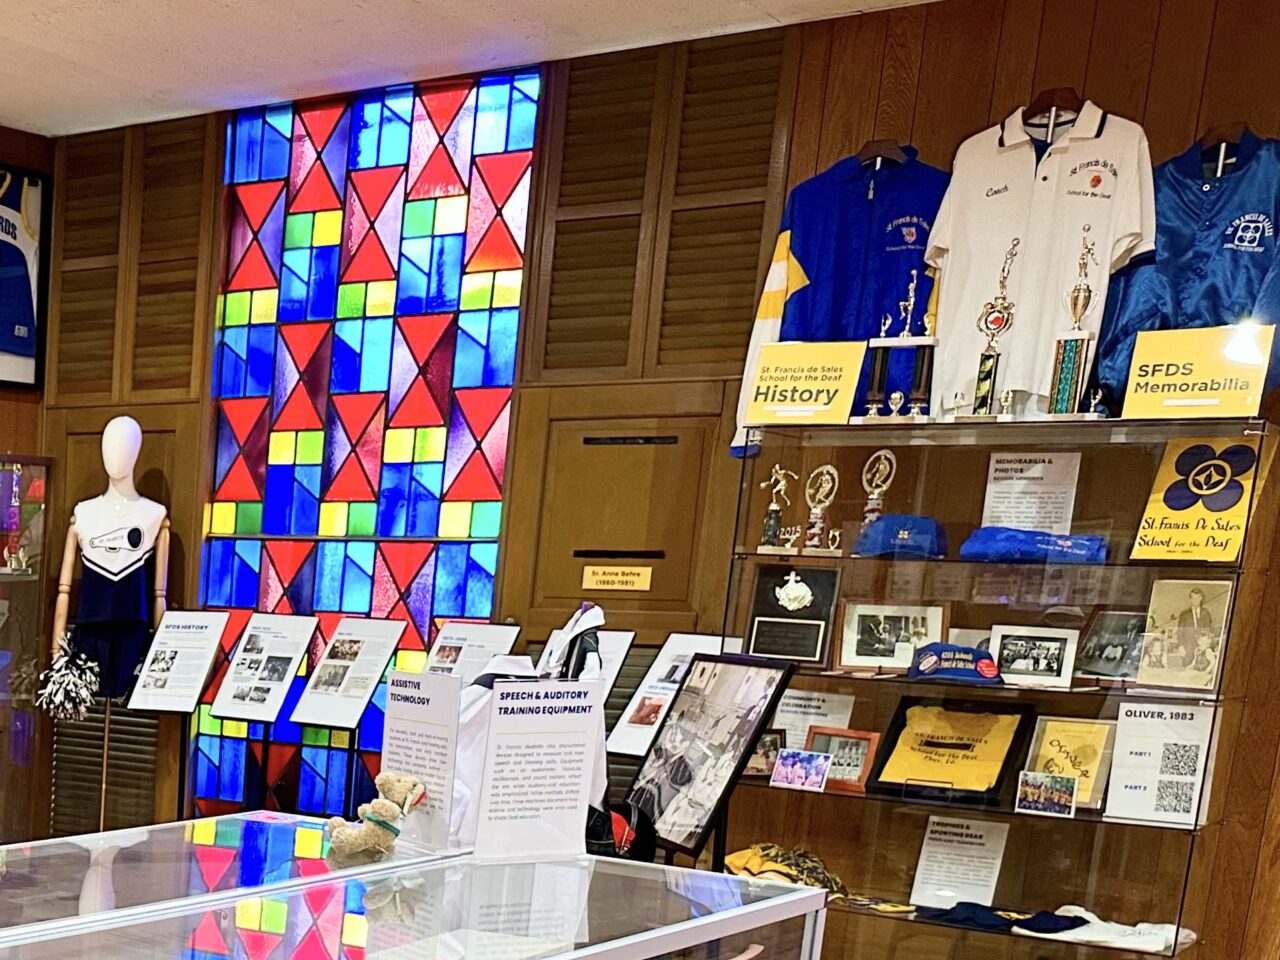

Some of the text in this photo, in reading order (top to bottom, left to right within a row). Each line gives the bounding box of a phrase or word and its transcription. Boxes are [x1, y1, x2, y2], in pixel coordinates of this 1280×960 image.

[1078, 158, 1100, 170] Francis
[986, 184, 1009, 197] Coach
[1137, 362, 1194, 377] SFDS
[1134, 378, 1249, 393] Memorabilia
[754, 384, 839, 406] History
[1142, 517, 1241, 531] St. Francis De Sales
[779, 525, 801, 538] 2015
[1138, 535, 1172, 547] School
[1204, 536, 1232, 551] Deaf
[391, 679, 421, 690] ASSISTIVE
[390, 693, 430, 706] TECHNOLOGY
[500, 691, 588, 700] SPEECH & AUDITORY
[498, 705, 592, 715] TRAINING EQUIPMENT
[1125, 710, 1194, 720] OLIVER, 1983
[932, 821, 964, 829] TROPHIES
[930, 830, 963, 838] SPORTING
